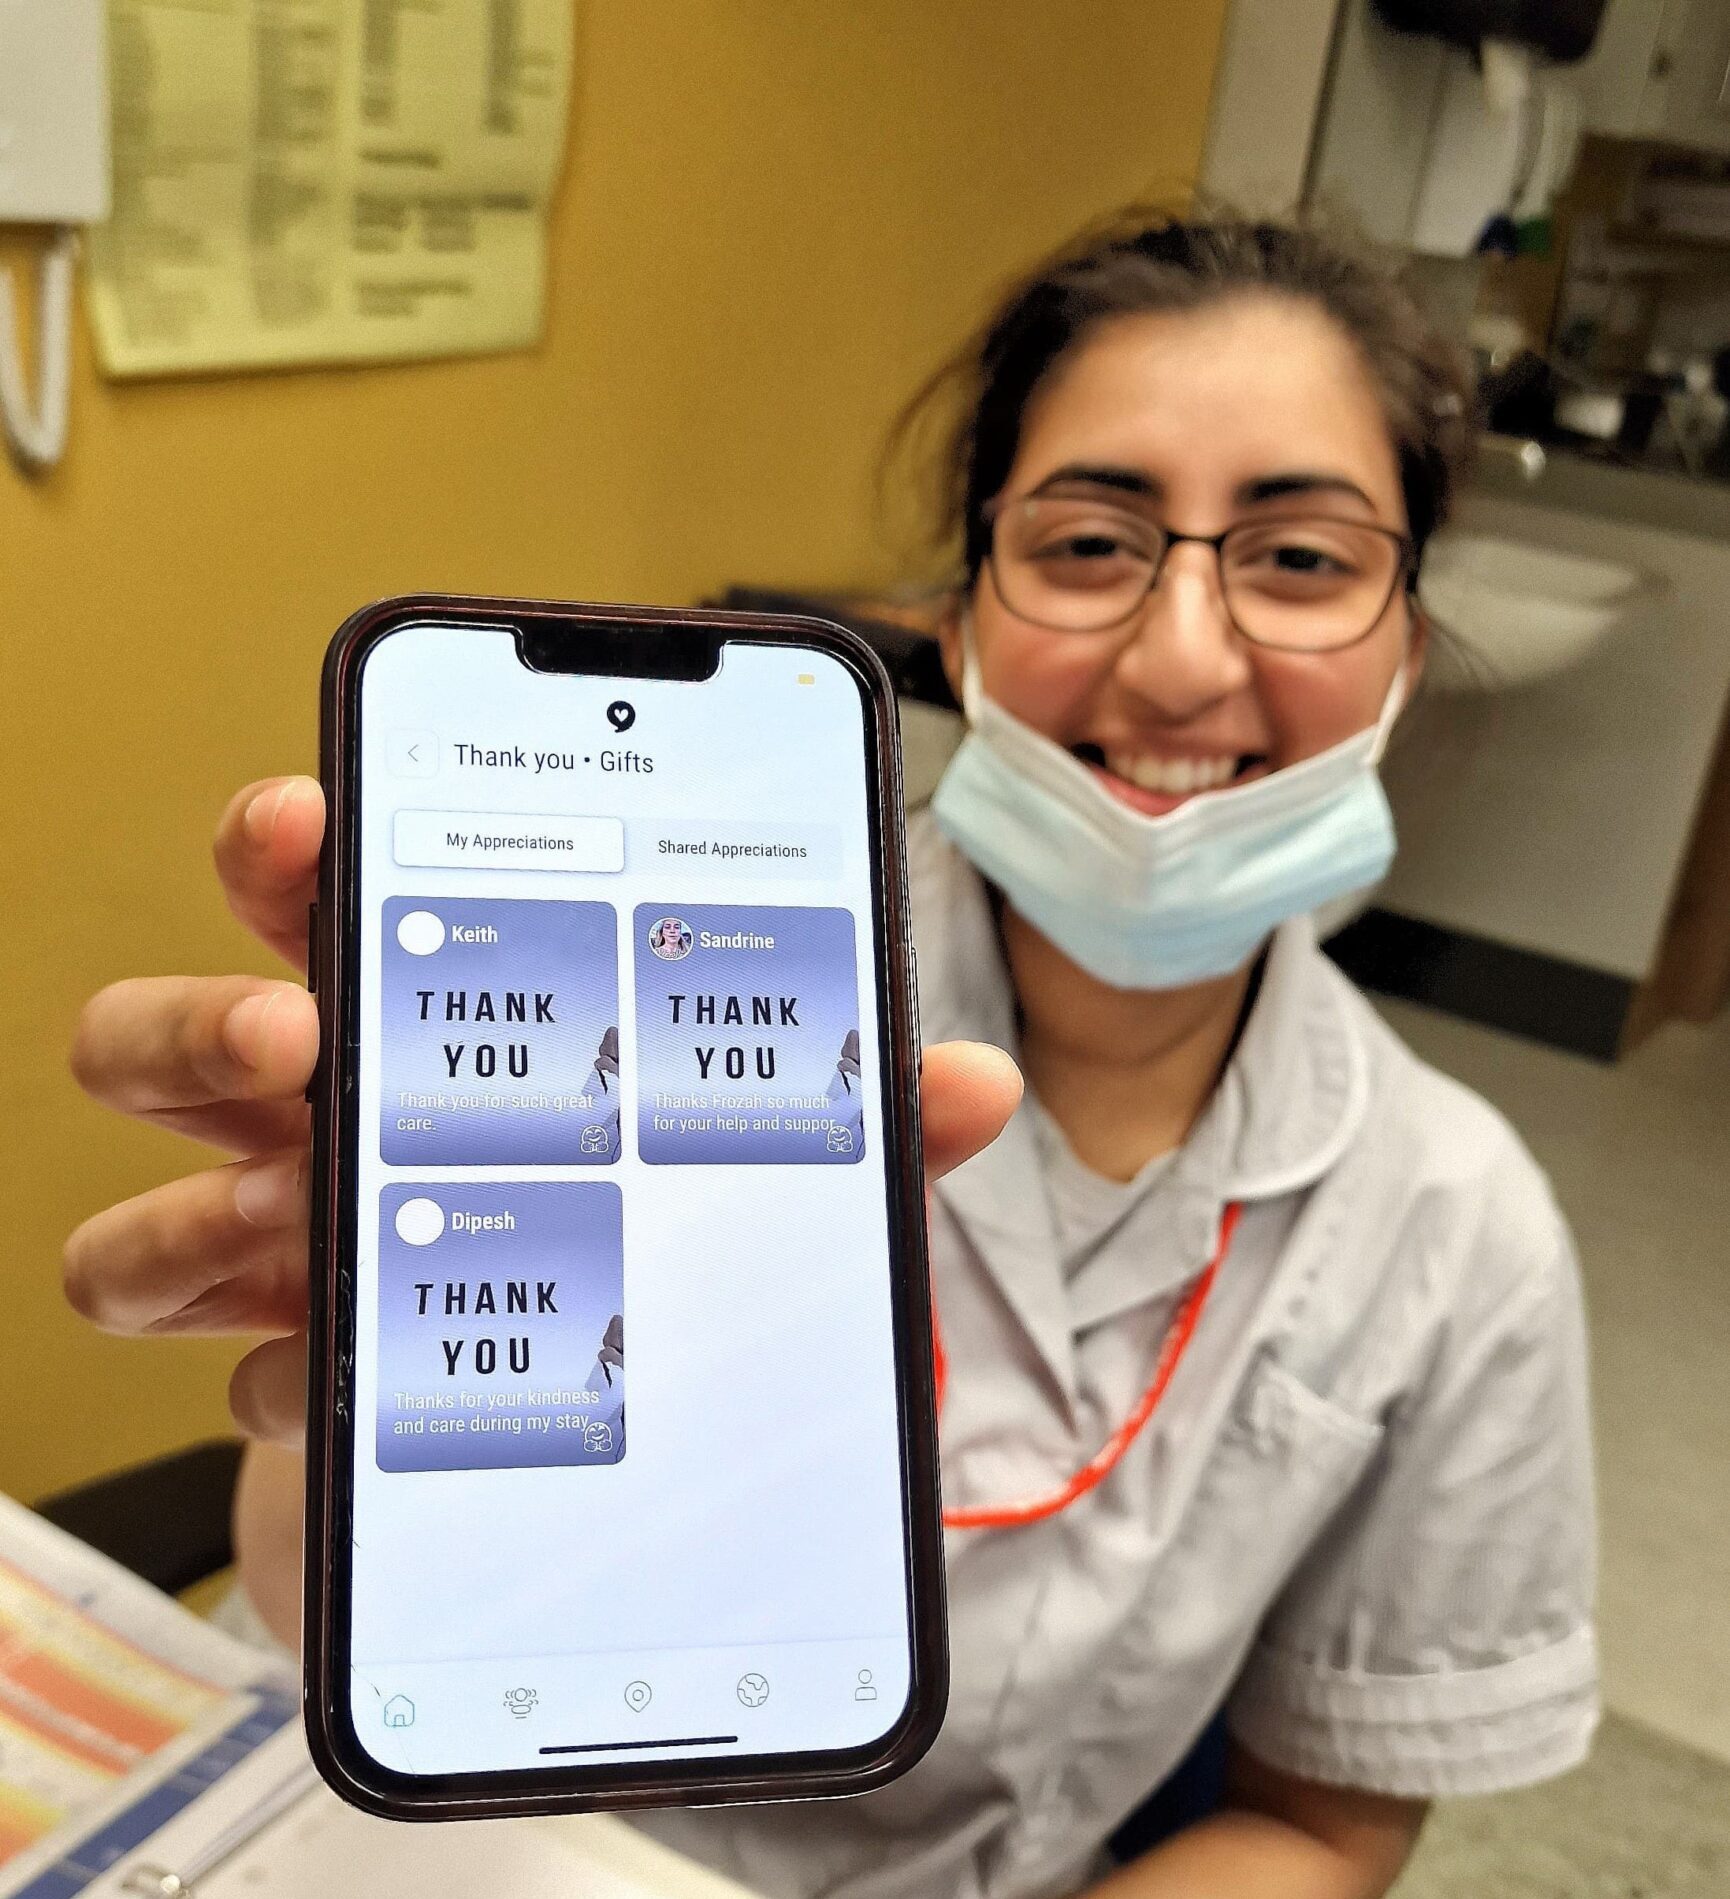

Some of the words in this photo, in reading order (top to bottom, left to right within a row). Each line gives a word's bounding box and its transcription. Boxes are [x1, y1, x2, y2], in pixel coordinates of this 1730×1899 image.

[454, 744, 527, 768] Thank
[534, 752, 575, 774] you
[600, 750, 654, 773] Gifts
[446, 833, 468, 850] My
[472, 834, 574, 851] Appreciations
[658, 840, 707, 855] Shared
[711, 842, 807, 859] Appreciations
[451, 925, 498, 943] Keith
[700, 931, 775, 949] Sandrine
[416, 991, 556, 1023] THANK
[668, 995, 800, 1026] THANK
[443, 1044, 529, 1078] YOU
[695, 1047, 776, 1080] YOU
[397, 1092, 446, 1108] Thank
[450, 1097, 480, 1112] you
[484, 1094, 506, 1108] for
[511, 1094, 548, 1109] such
[553, 1095, 595, 1112] great
[655, 1093, 708, 1109] Thanks
[713, 1094, 762, 1109] Frozah
[767, 1098, 785, 1109] so
[789, 1094, 829, 1109] much
[397, 1118, 437, 1131] care.
[654, 1115, 675, 1131] for
[679, 1119, 712, 1134] your
[716, 1115, 748, 1134] help
[752, 1115, 780, 1131] and
[451, 1211, 515, 1234] Dipesh
[414, 1282, 559, 1315] THANK
[442, 1337, 530, 1376] YOU
[394, 1392, 454, 1410] Thanks
[460, 1391, 483, 1408] for
[487, 1393, 522, 1411] your
[527, 1389, 600, 1406] kindness
[394, 1417, 424, 1434] and
[429, 1418, 465, 1433] care
[470, 1414, 522, 1434] during
[527, 1415, 551, 1432] my
